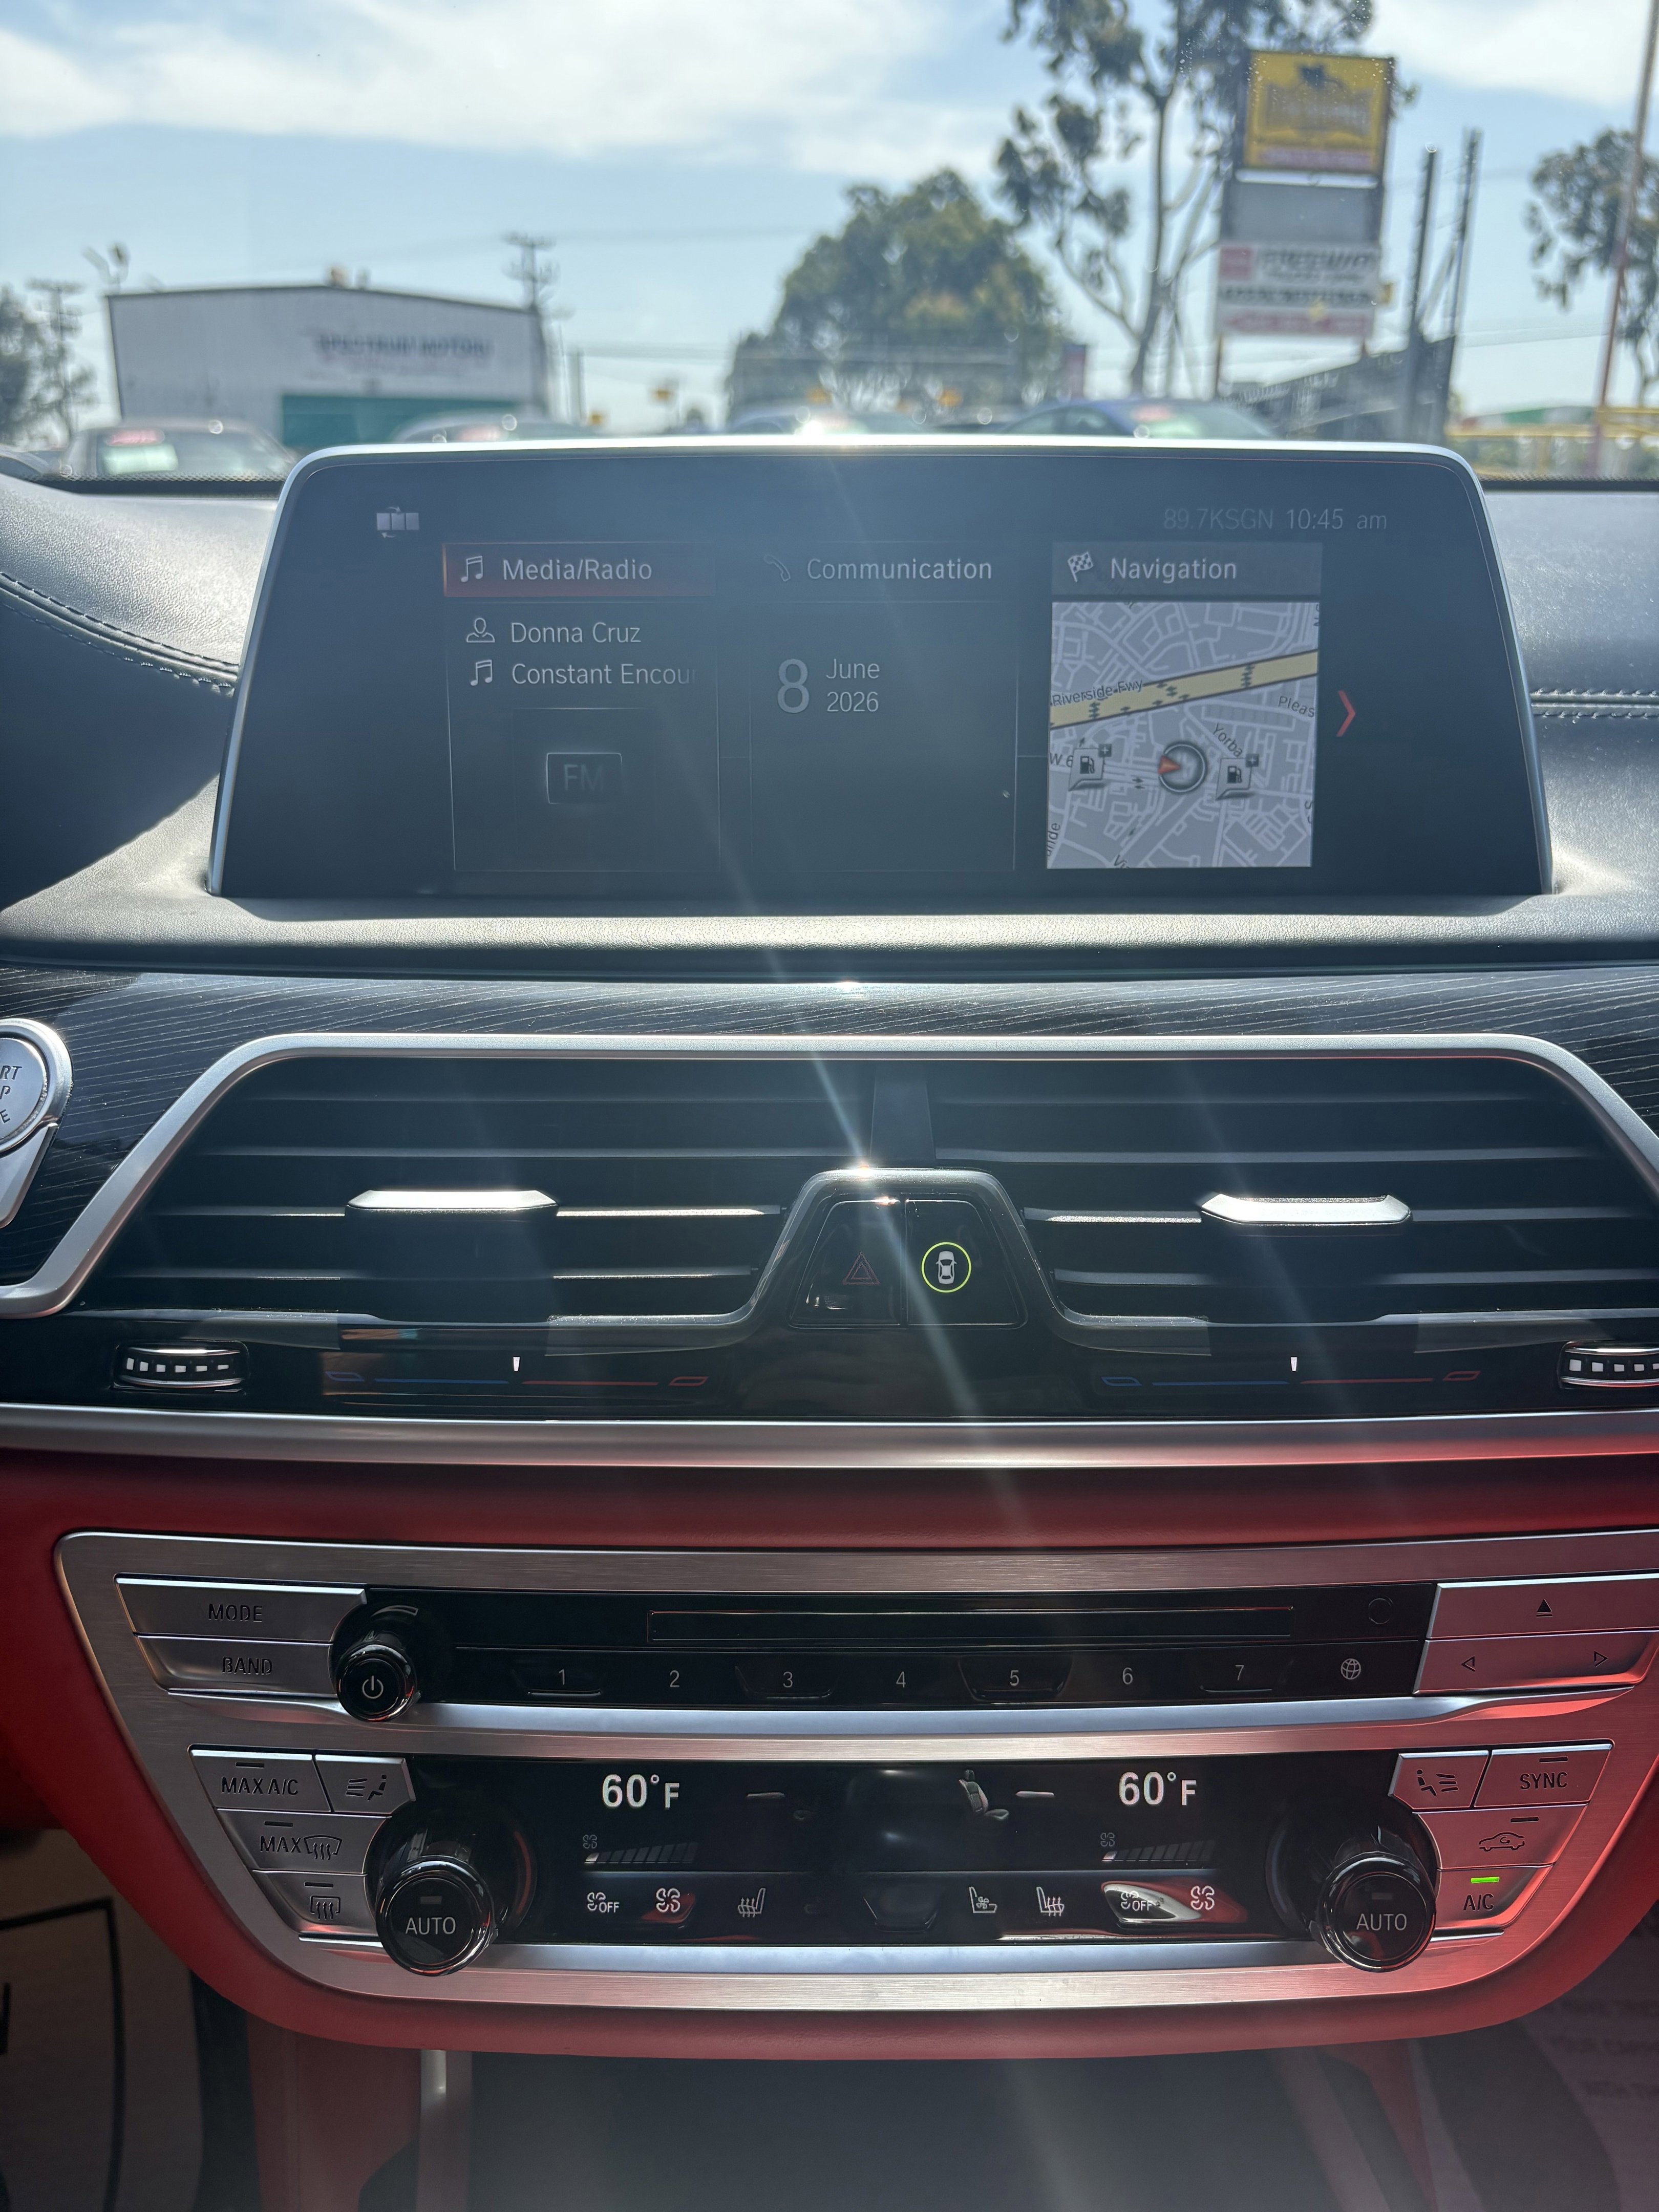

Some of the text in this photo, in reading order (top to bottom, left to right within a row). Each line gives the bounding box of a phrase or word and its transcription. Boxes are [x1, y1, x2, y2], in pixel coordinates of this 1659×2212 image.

[1286, 507, 1344, 530] 10:45
[1356, 514, 1387, 530] am
[502, 558, 652, 581] Media/Radio
[806, 557, 992, 580] Communication
[1110, 557, 1237, 584] Navigation
[512, 621, 642, 643] Donna Cruz
[512, 663, 612, 685] Constant
[825, 658, 880, 680] June
[777, 658, 810, 713] 8
[1052, 680, 1143, 707] Riverside Fwy
[826, 691, 879, 712] 2026
[1278, 695, 1315, 718] Pleas
[1213, 722, 1243, 758] Yorba
[1050, 752, 1063, 766] W
[563, 763, 604, 792] FM
[207, 1603, 263, 1623] MODE
[221, 1657, 273, 1676] BAND
[558, 1665, 1245, 1688] 1 2 3 4 5 6 7
[221, 1777, 299, 1796] MAX A/C
[1519, 1771, 1569, 1791] SYNC
[259, 1836, 302, 1854] MAX
[599, 1902, 620, 1913] OFF
[1132, 1900, 1153, 1912] OFF
[1462, 1893, 1495, 1912] A/C
[405, 1917, 457, 1936] AUTO
[1355, 1913, 1408, 1932] AUTO
